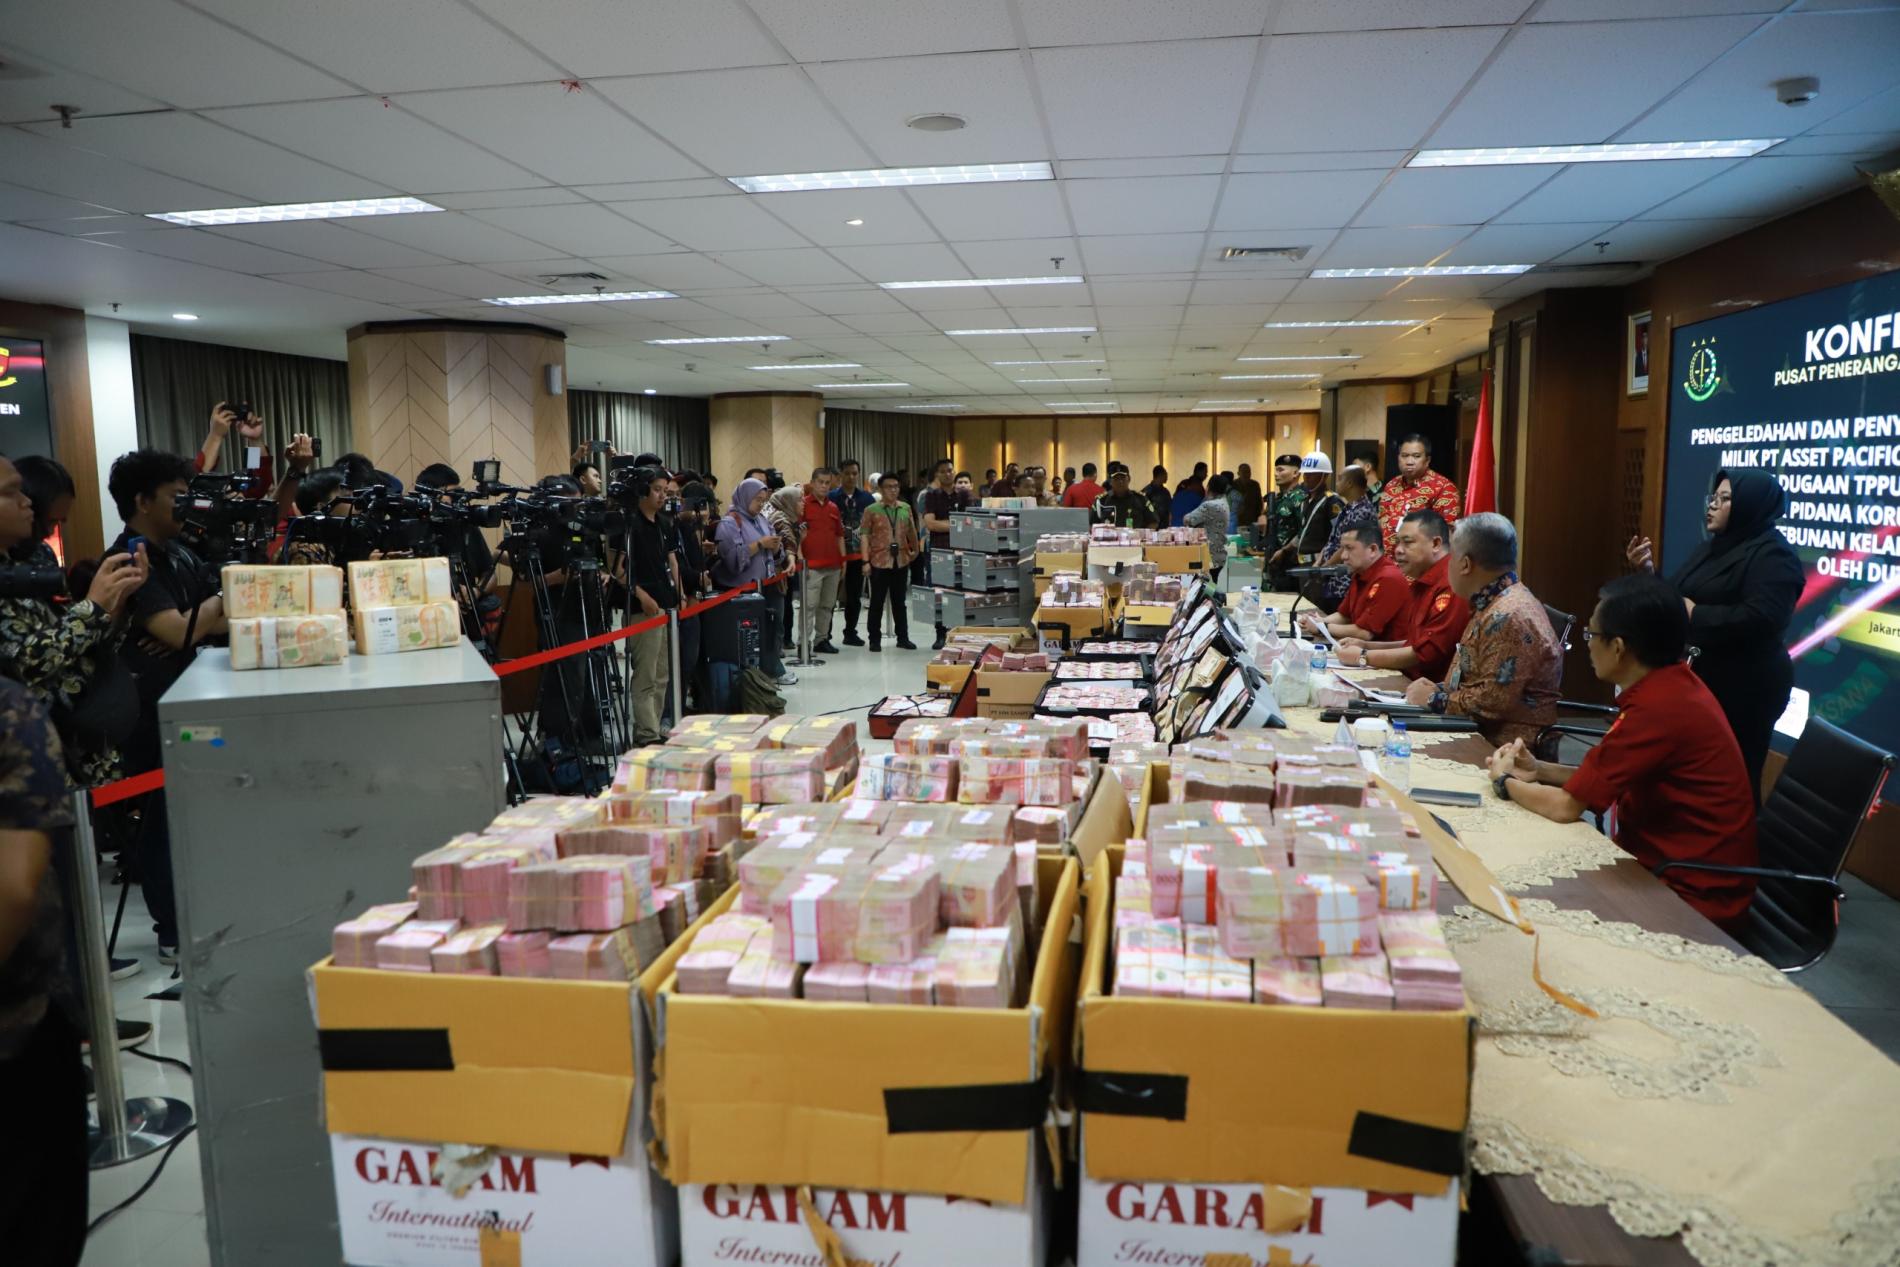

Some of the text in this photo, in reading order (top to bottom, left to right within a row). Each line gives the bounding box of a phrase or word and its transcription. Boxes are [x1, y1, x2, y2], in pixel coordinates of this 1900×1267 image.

[1774, 353, 1900, 387] PUSAT PENERANG
[1691, 420, 1807, 445] PENGGELEDAHAN
[1810, 418, 1850, 440] DAN
[1721, 449, 1759, 468] MILIK
[1761, 449, 1780, 468] PT
[1781, 447, 1829, 468] ASSET
[1778, 473, 1900, 497] DUGAAN TPPU
[1789, 501, 1853, 524] PIDANA
[1817, 556, 1900, 583] OLEH DU
